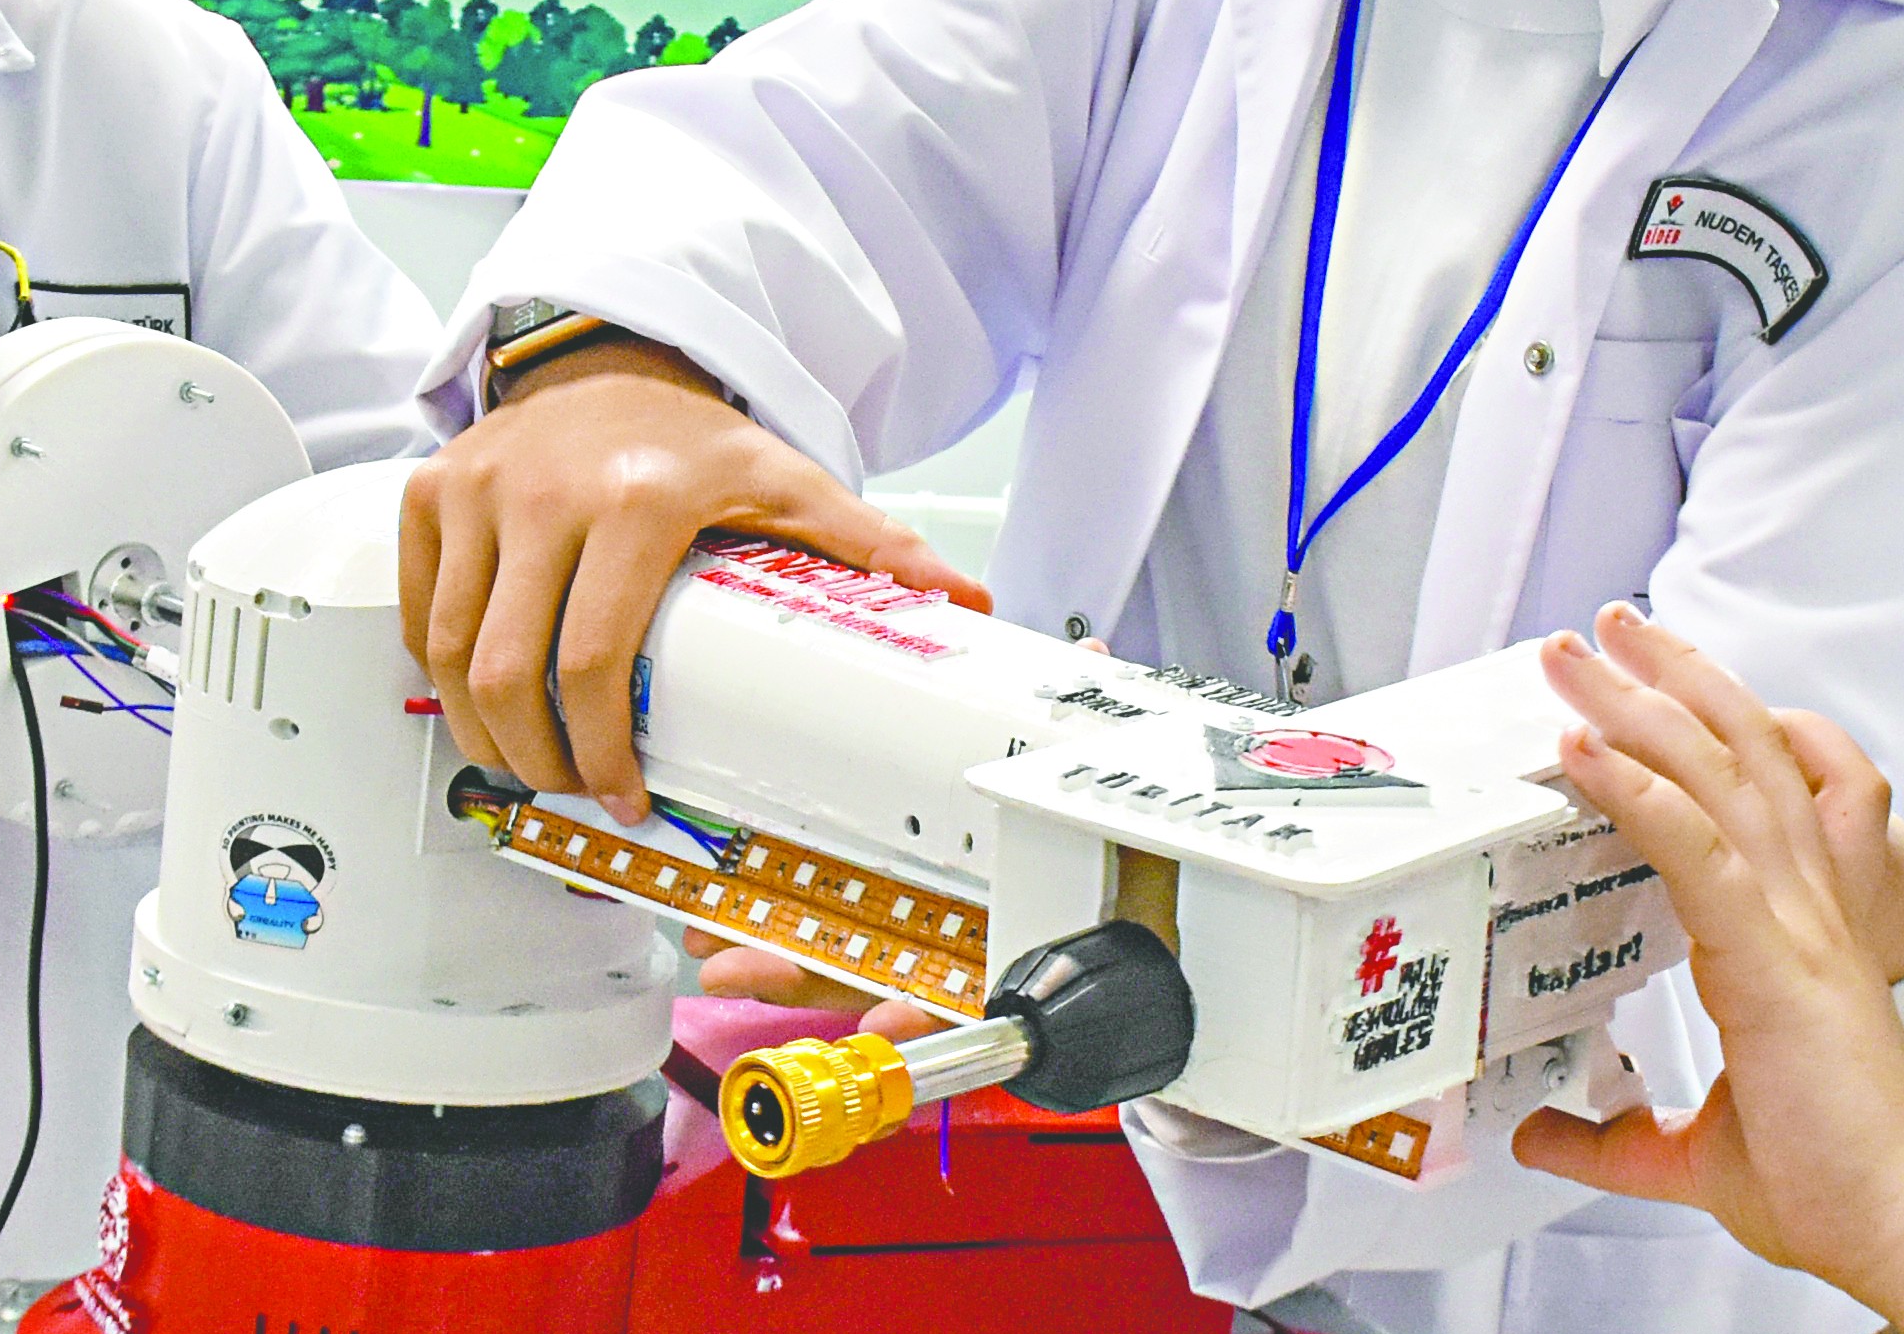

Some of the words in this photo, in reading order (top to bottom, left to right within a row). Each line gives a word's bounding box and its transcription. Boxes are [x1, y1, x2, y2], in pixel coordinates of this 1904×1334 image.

[1696, 210, 1764, 252] NUDEM
[267, 813, 301, 829] MAKES
[302, 825, 318, 839] ME
[316, 837, 337, 871] HAPPY
